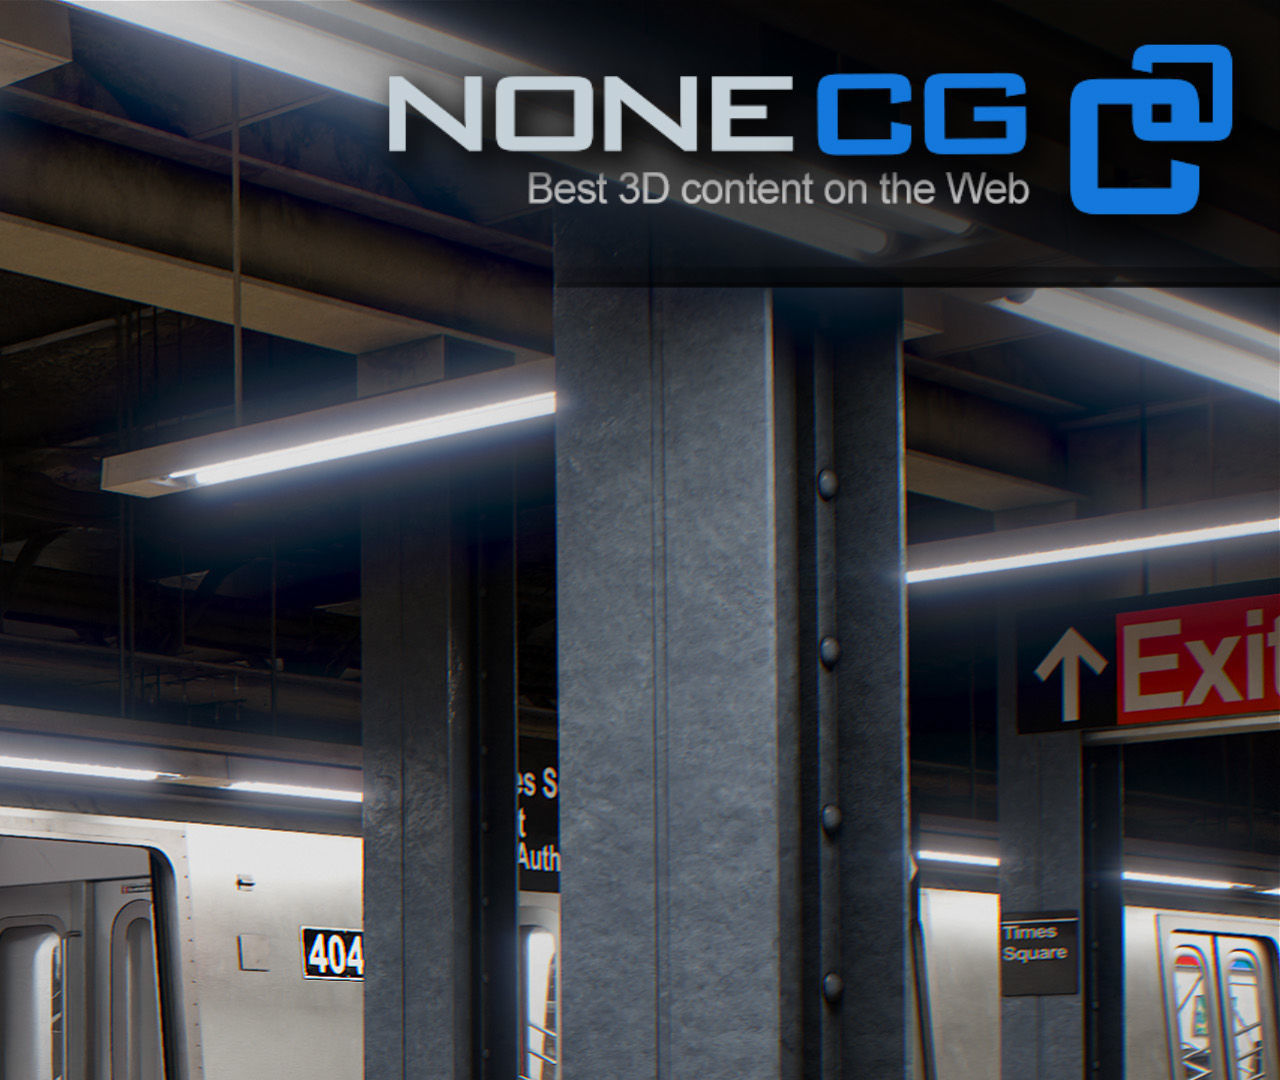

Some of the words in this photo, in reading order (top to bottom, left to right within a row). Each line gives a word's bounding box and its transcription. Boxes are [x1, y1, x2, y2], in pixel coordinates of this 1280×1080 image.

[1001, 924, 1059, 940] Times
[307, 933, 366, 976] 404
[1001, 946, 1069, 964] Square
